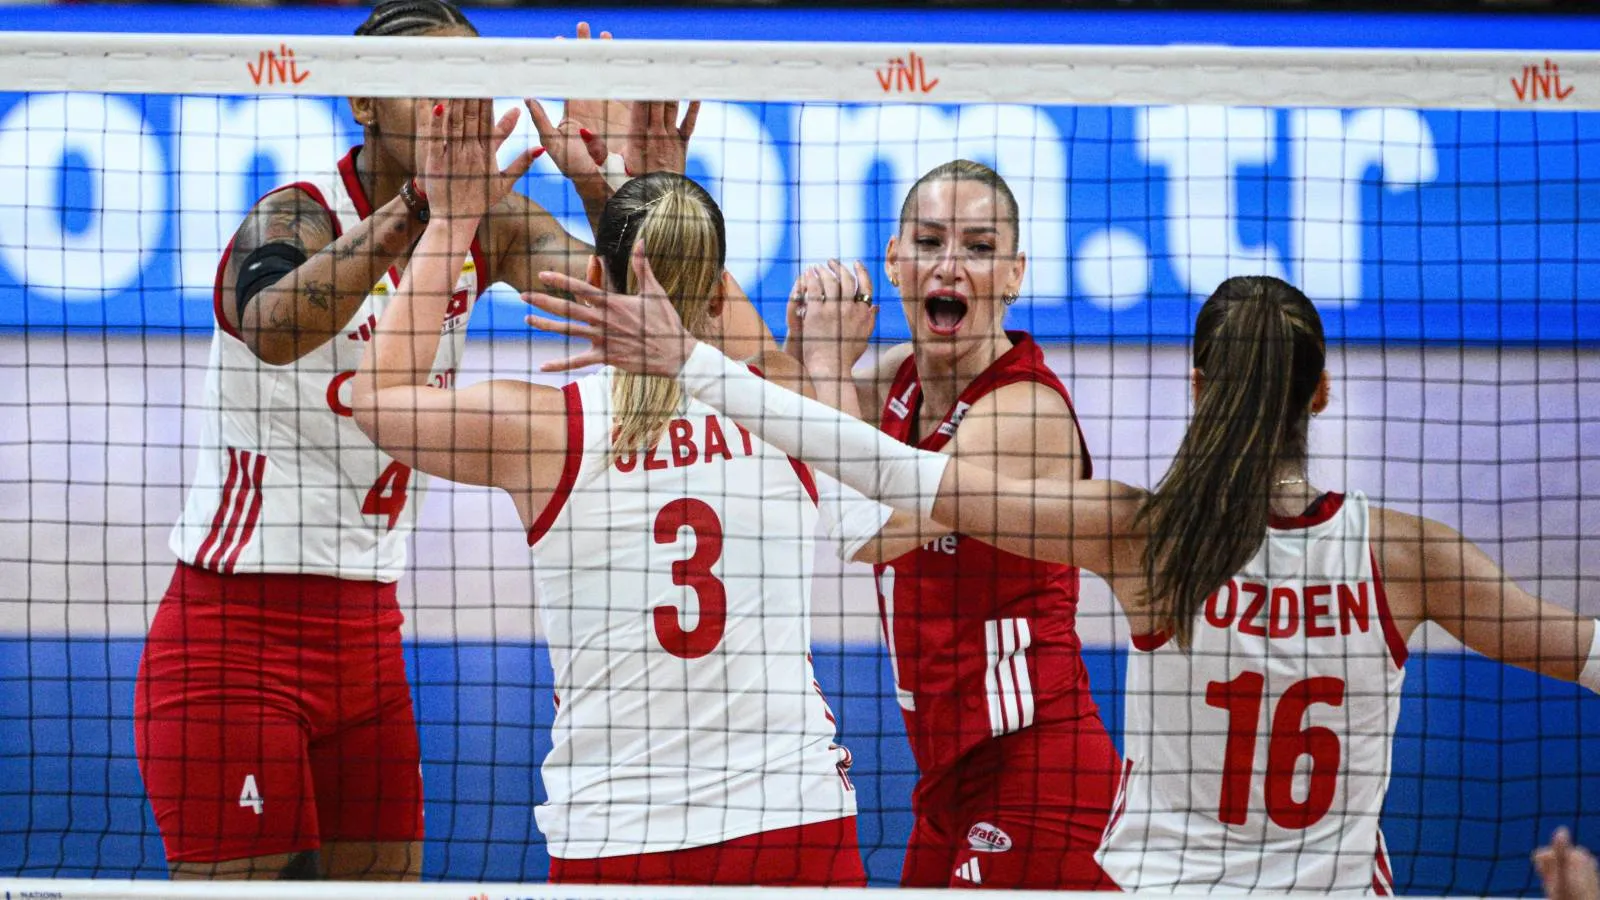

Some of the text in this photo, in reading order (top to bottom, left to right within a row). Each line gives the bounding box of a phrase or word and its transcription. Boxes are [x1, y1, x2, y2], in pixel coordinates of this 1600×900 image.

[247, 43, 310, 85] VNL
[876, 51, 939, 93] VNL
[1510, 58, 1574, 102] VNL
[361, 460, 411, 532] 4
[653, 498, 727, 659] 3
[1205, 670, 1345, 830] 16
[239, 774, 263, 815] 4
[968, 825, 1007, 846] gratis
